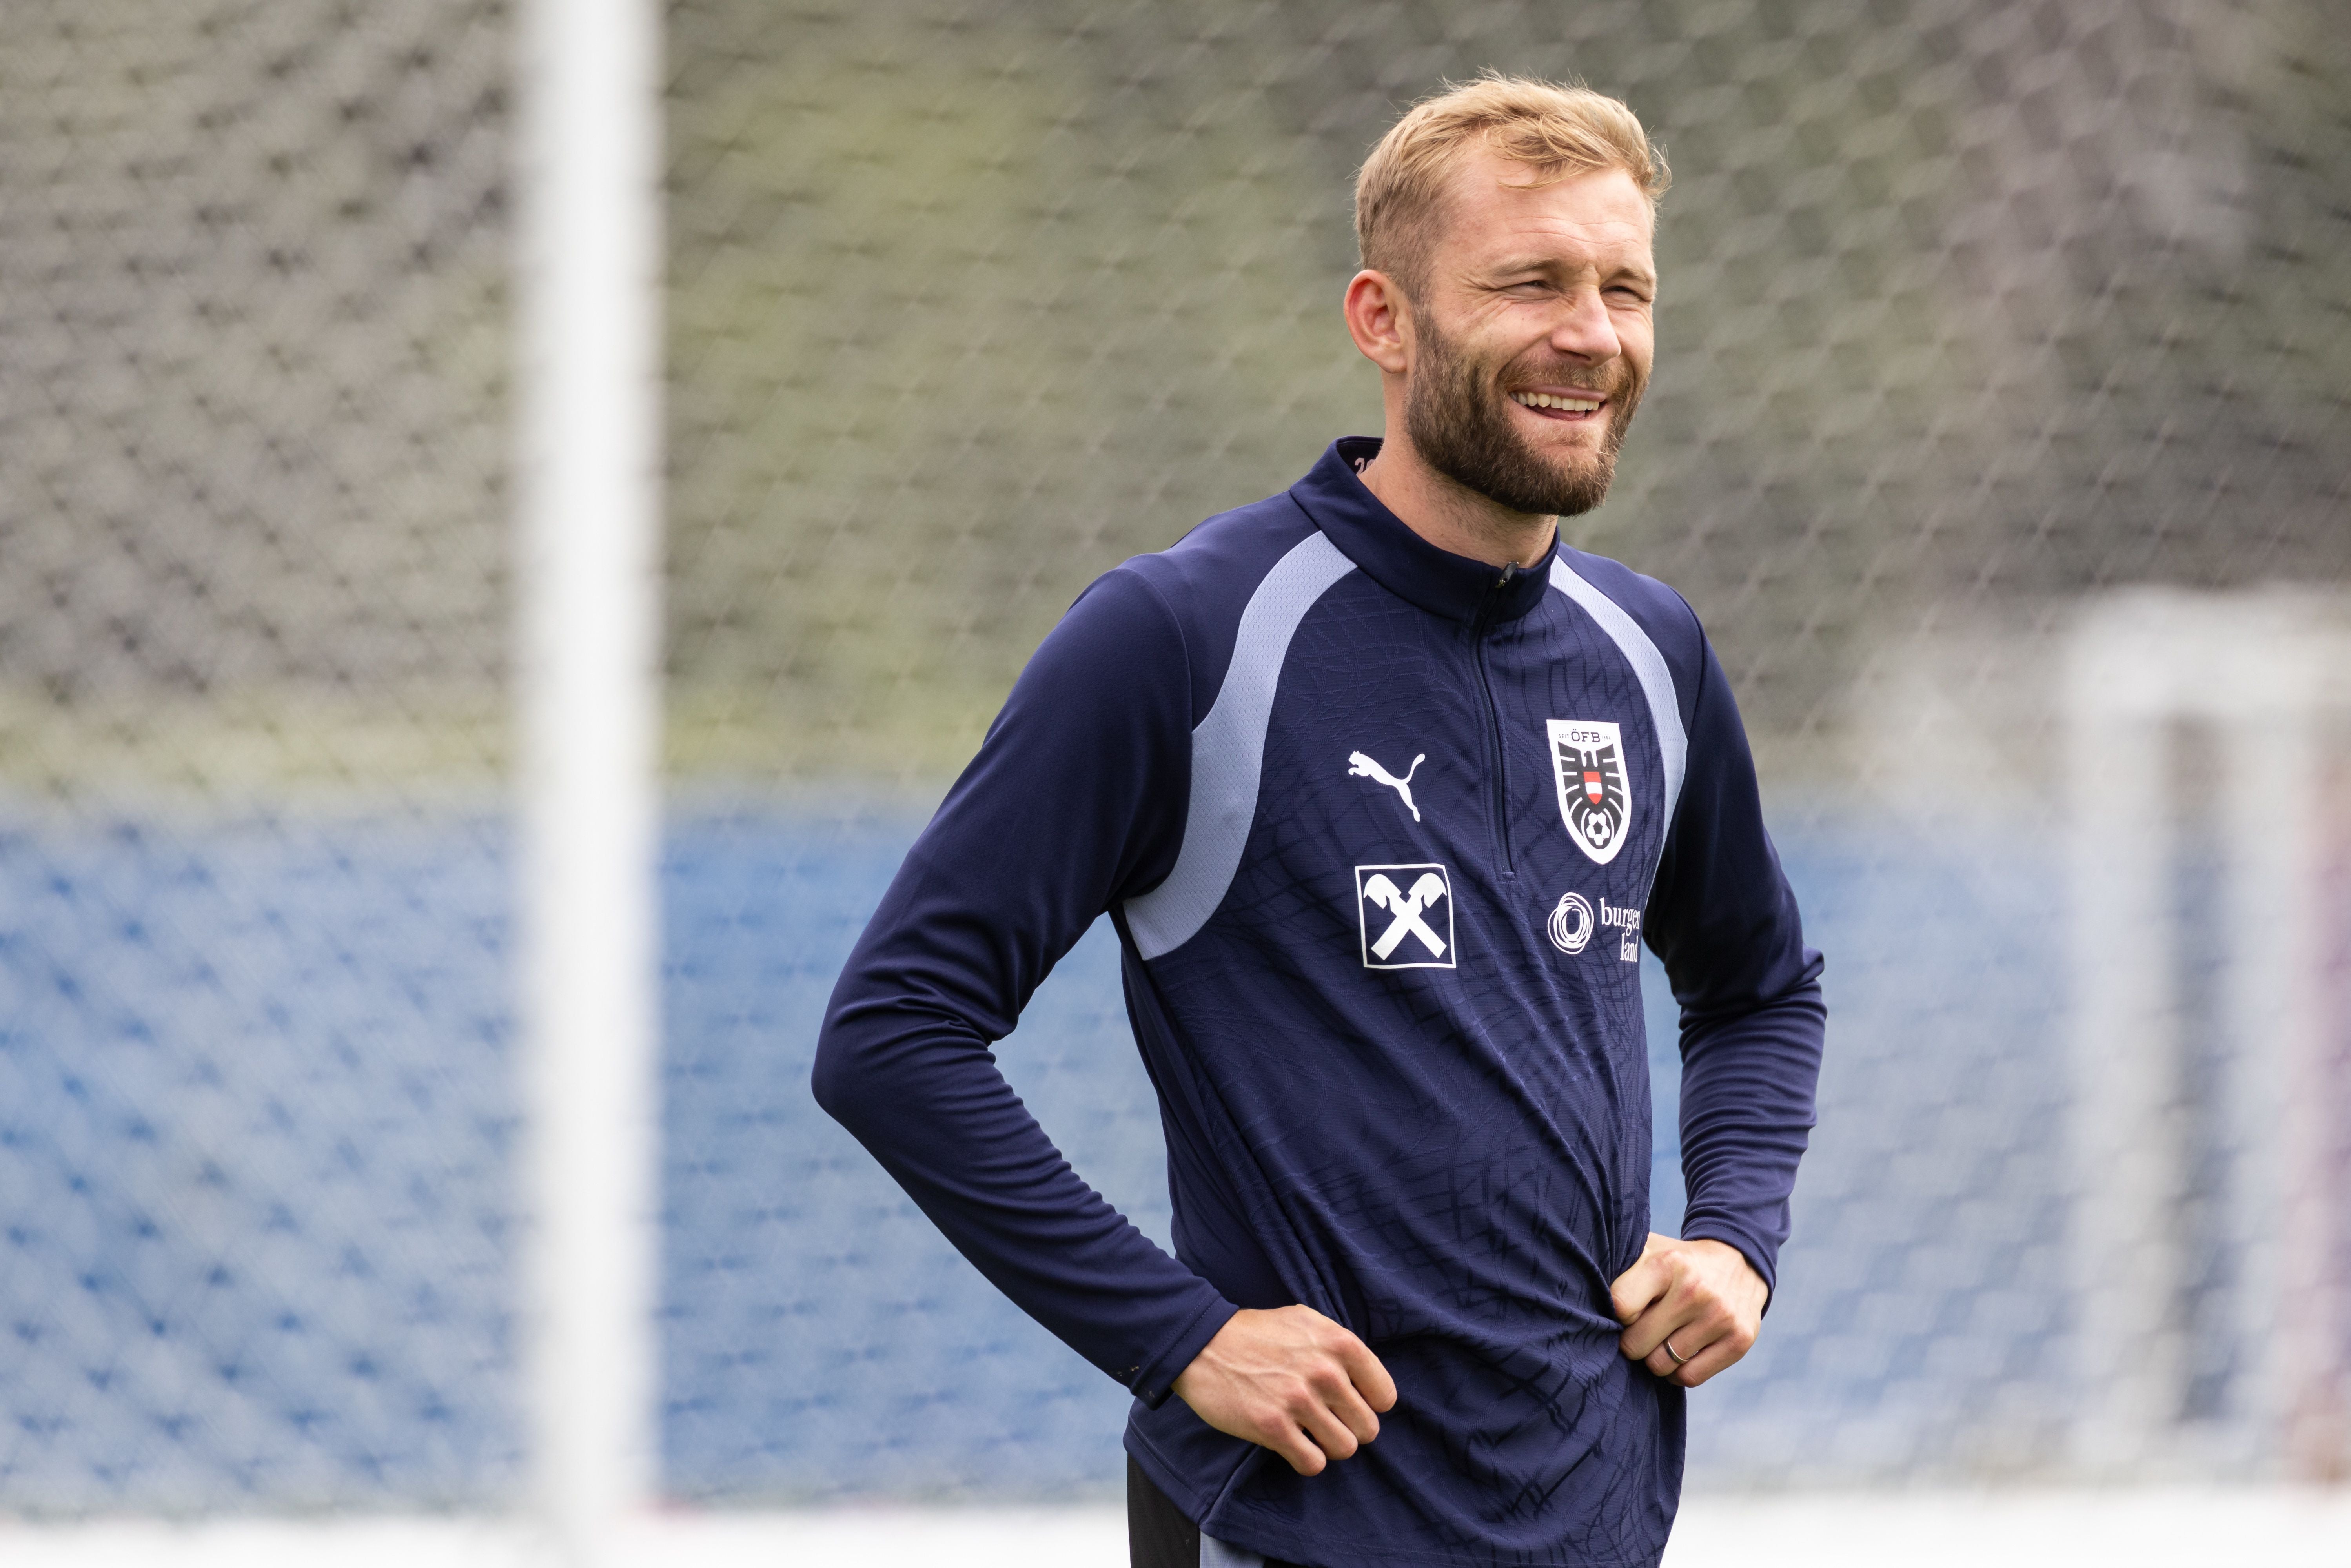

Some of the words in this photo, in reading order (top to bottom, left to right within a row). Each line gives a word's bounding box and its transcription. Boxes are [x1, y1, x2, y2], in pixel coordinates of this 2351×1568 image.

[1571, 728, 1601, 743] ÖFB
[1599, 897, 1641, 936] burgen
[1620, 932, 1639, 962] land
